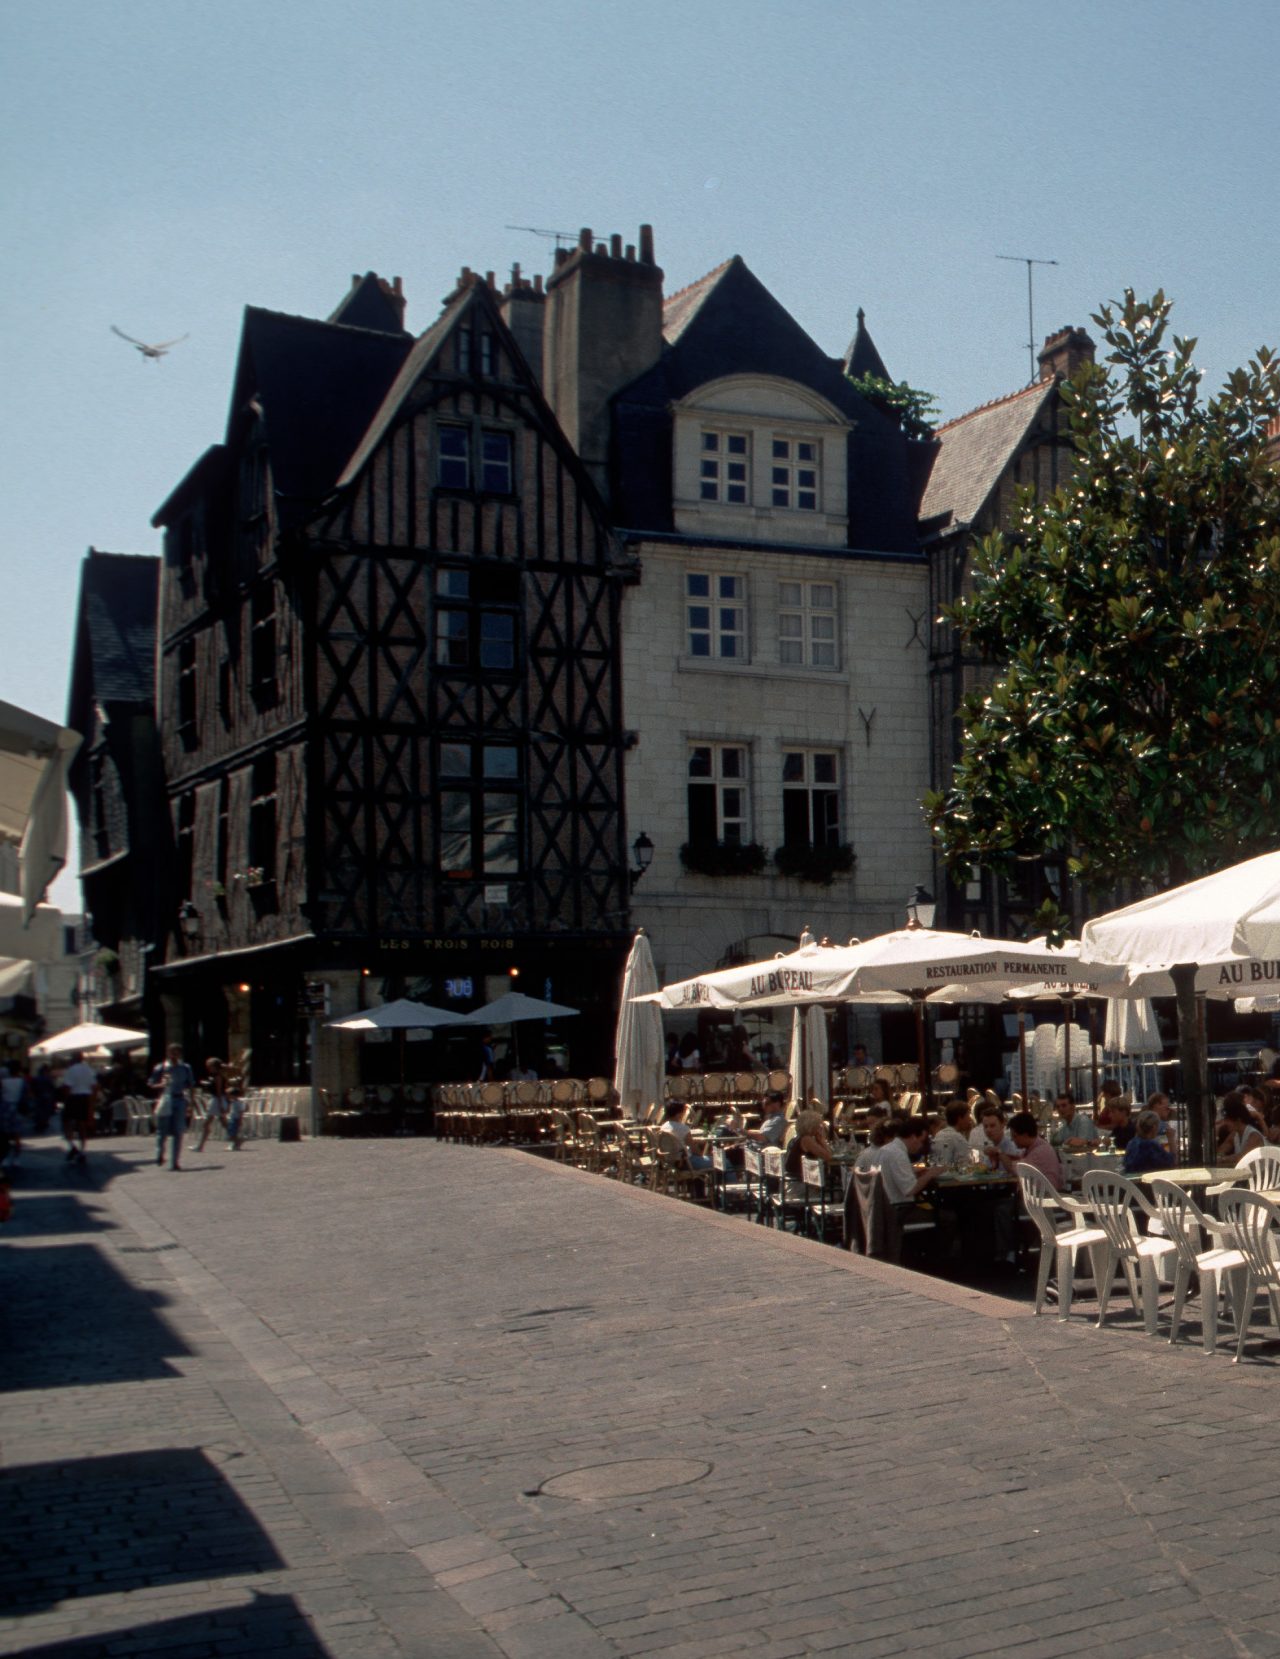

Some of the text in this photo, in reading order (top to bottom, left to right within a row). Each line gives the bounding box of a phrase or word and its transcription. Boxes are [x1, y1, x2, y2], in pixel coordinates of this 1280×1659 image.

[380, 939, 514, 949] LES TROIS ROIS
[926, 962, 1068, 979] RESTAURATION PERMANENTE
[1218, 963, 1244, 985] AU
[751, 970, 813, 996] AU BUREAU
